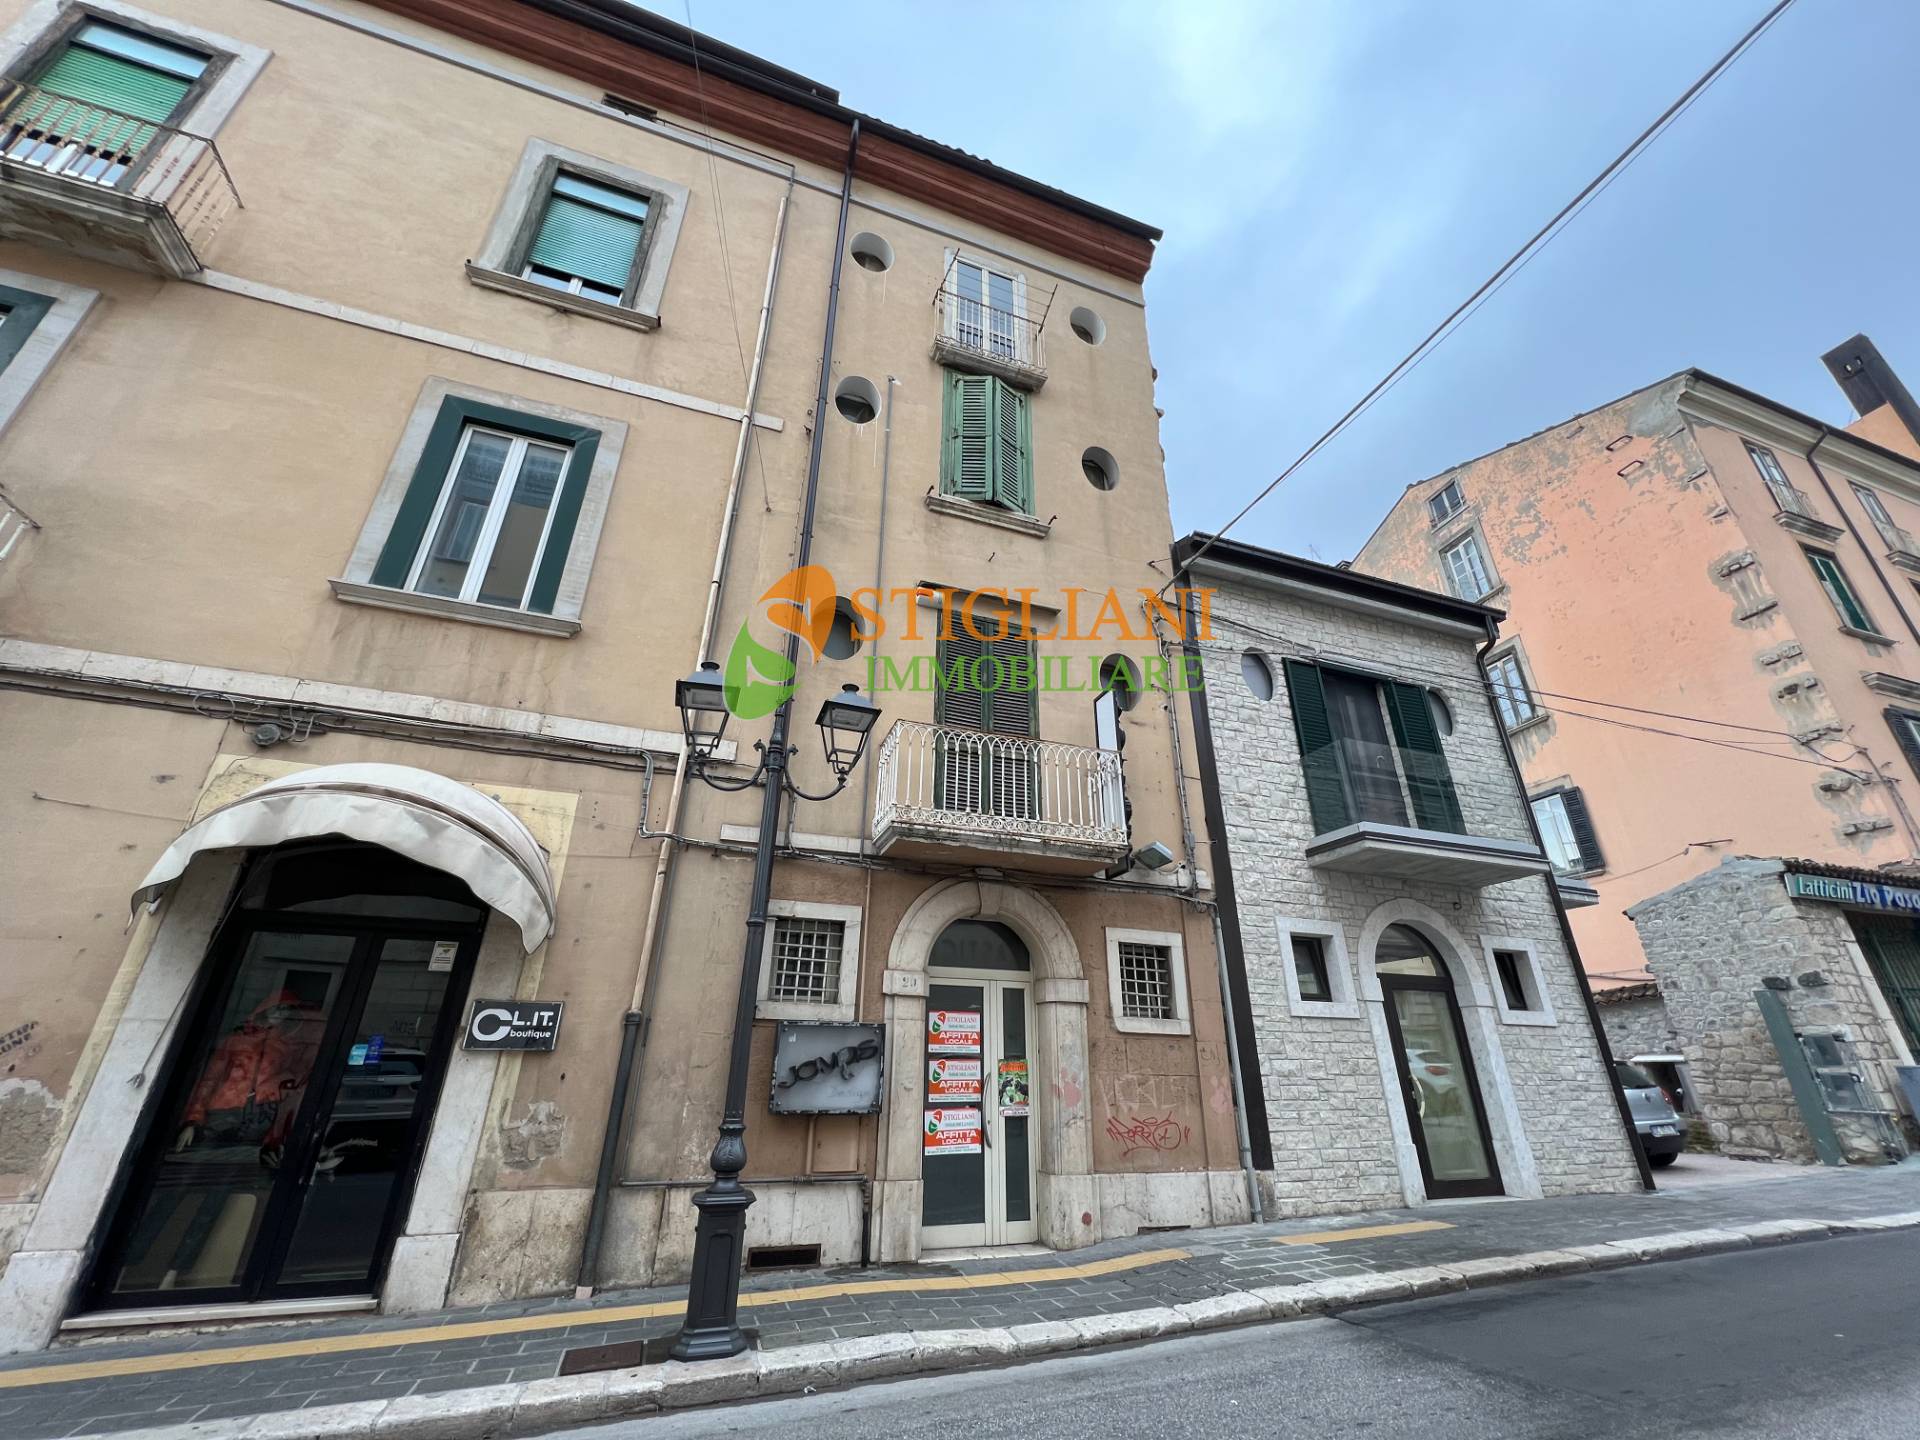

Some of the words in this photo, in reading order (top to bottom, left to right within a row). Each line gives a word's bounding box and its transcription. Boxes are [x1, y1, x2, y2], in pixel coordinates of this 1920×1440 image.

[1799, 877, 1854, 900] Latticini
[1852, 881, 1881, 904] Zio
[510, 1028, 552, 1040] boutique
[939, 1031, 979, 1040] AFFITTA
[939, 1080, 980, 1089] AFFITTA
[935, 1129, 977, 1140] AFFITTA
[941, 1137, 972, 1145] LOCALE
